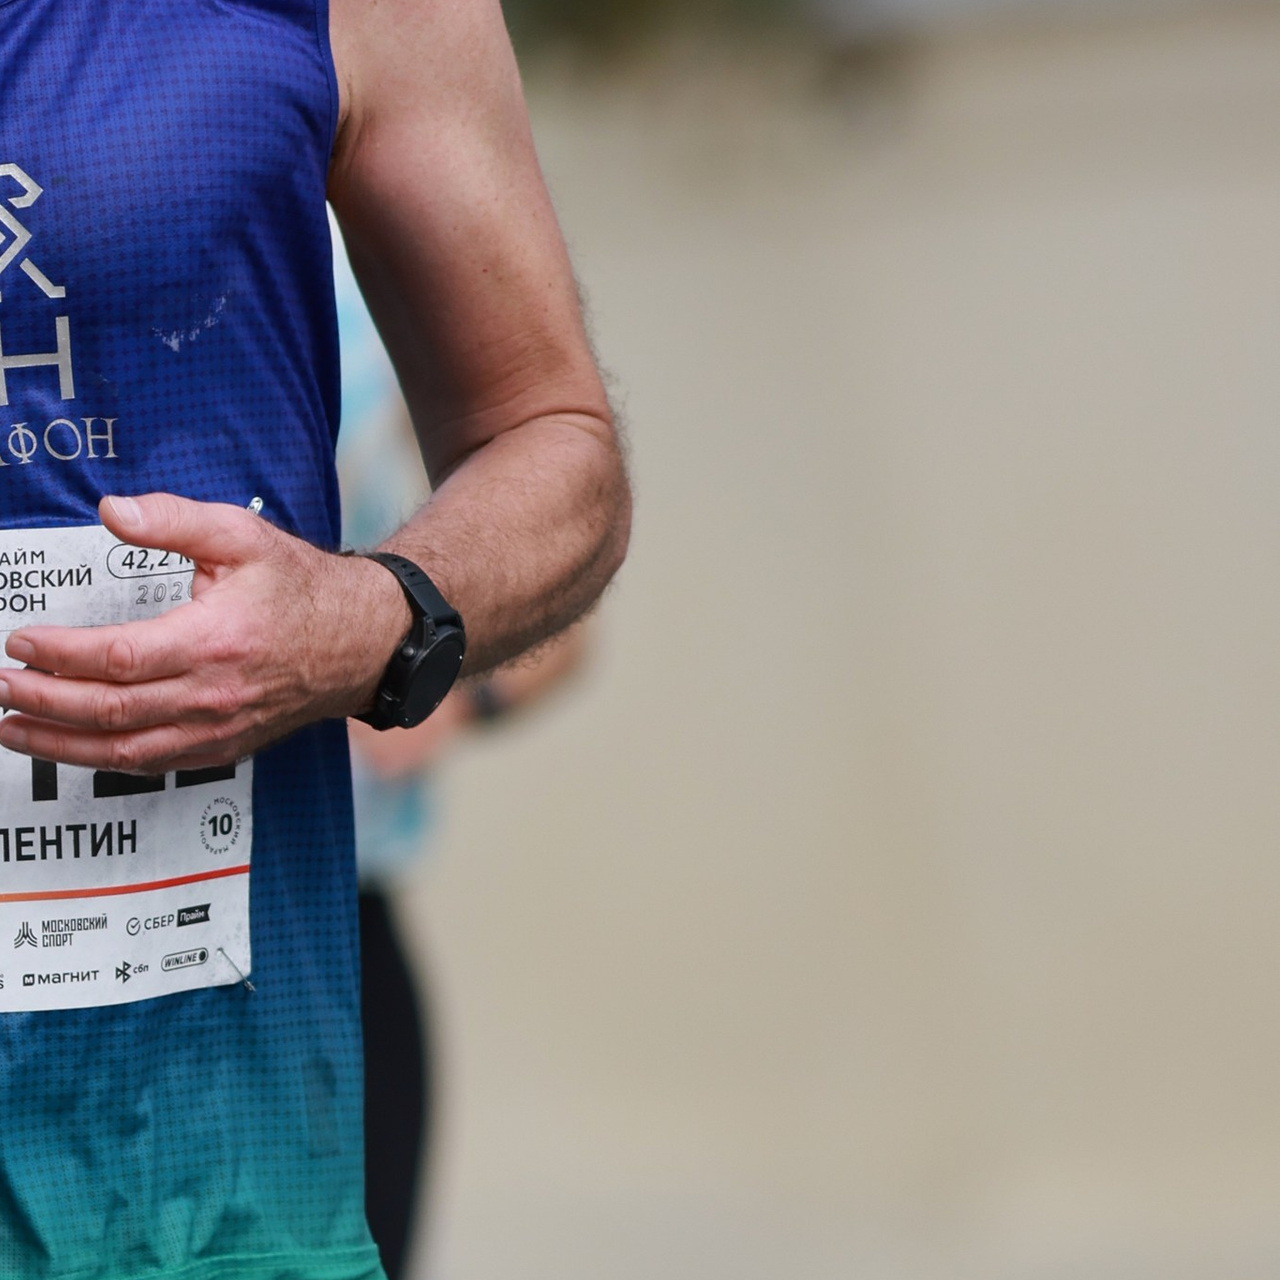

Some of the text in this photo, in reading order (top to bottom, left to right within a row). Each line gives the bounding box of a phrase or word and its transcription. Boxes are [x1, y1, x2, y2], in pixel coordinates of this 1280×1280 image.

[121, 549, 169, 571] 42,2
[135, 581, 193, 605] 202
[208, 813, 233, 837] 10
[42, 913, 107, 933] МОСКОВСКИЙ
[144, 914, 174, 930] СБЕР
[42, 933, 74, 948] СПОРТ
[164, 952, 198, 969] WINLINE
[38, 969, 100, 985] магнит
